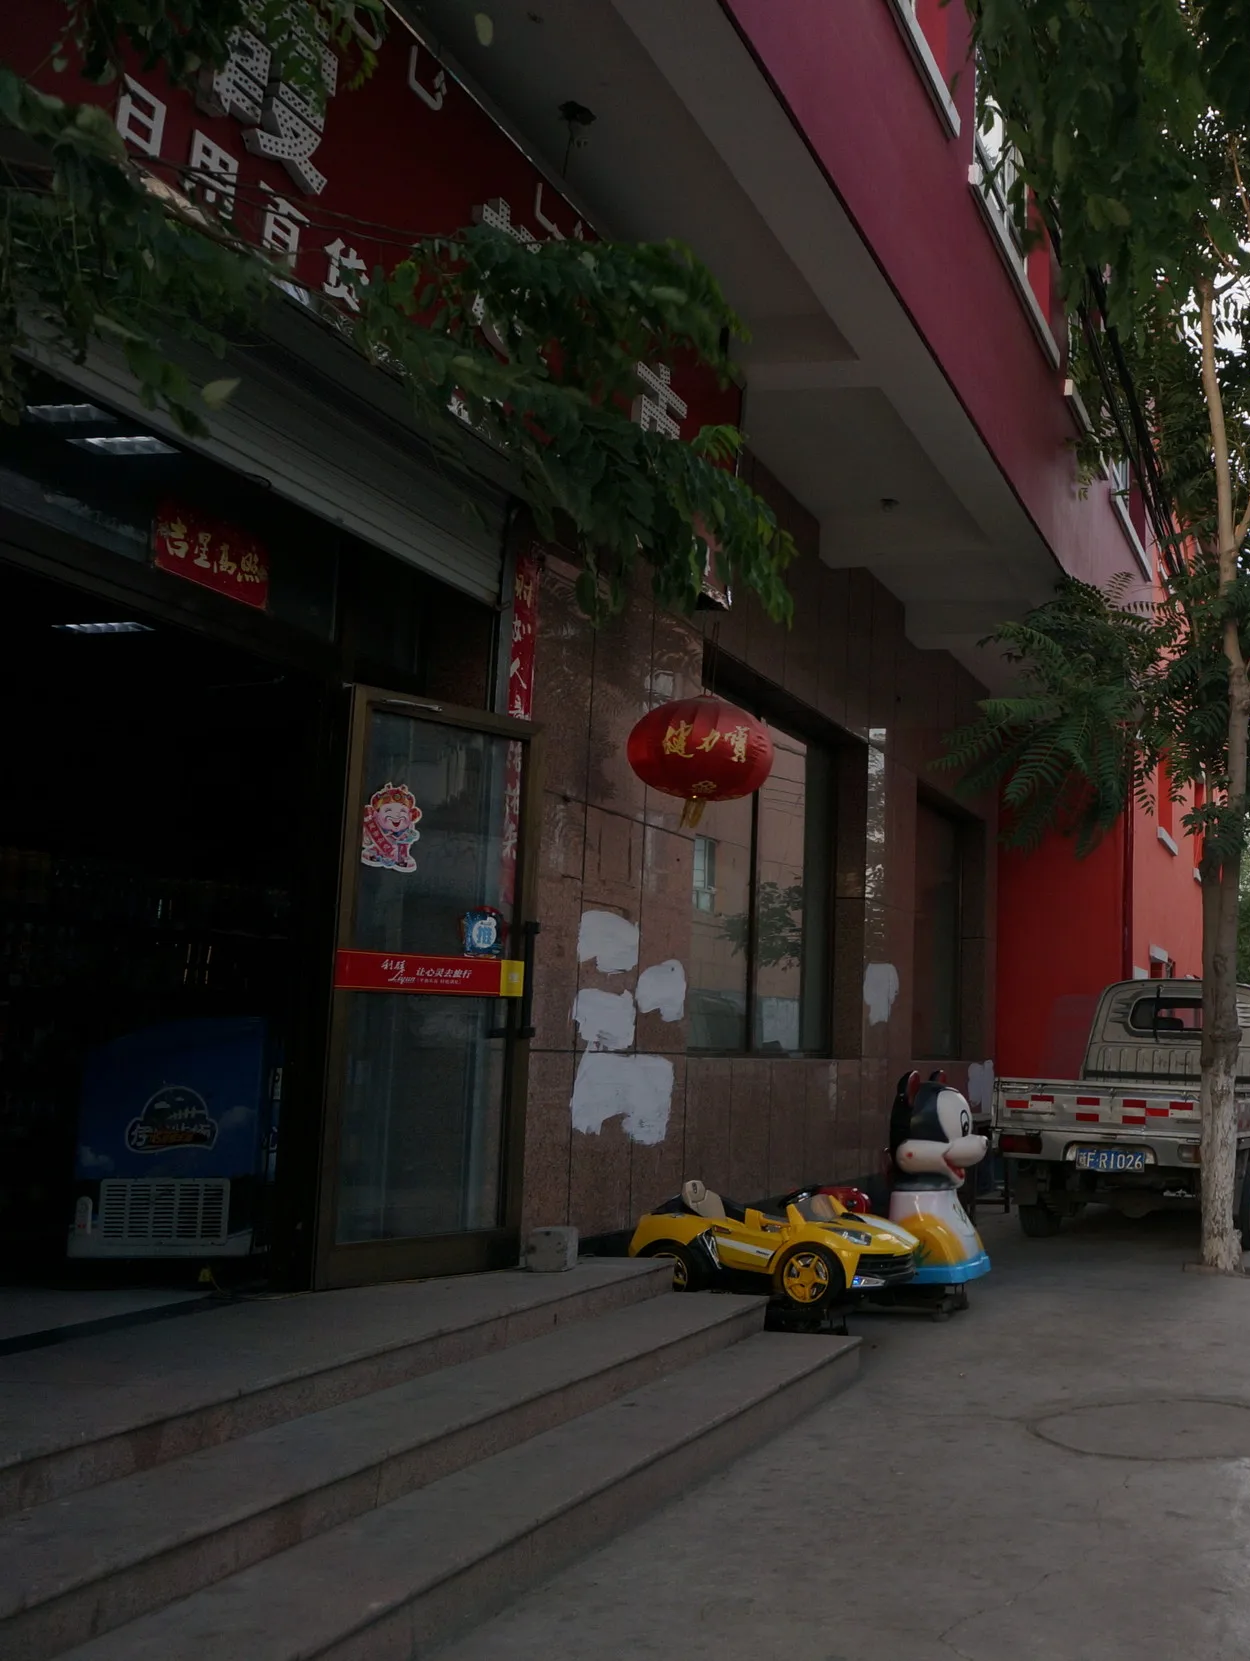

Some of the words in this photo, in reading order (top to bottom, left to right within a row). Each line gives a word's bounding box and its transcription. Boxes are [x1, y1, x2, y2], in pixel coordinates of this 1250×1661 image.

[416, 967, 472, 979] 让心灵去旅行
